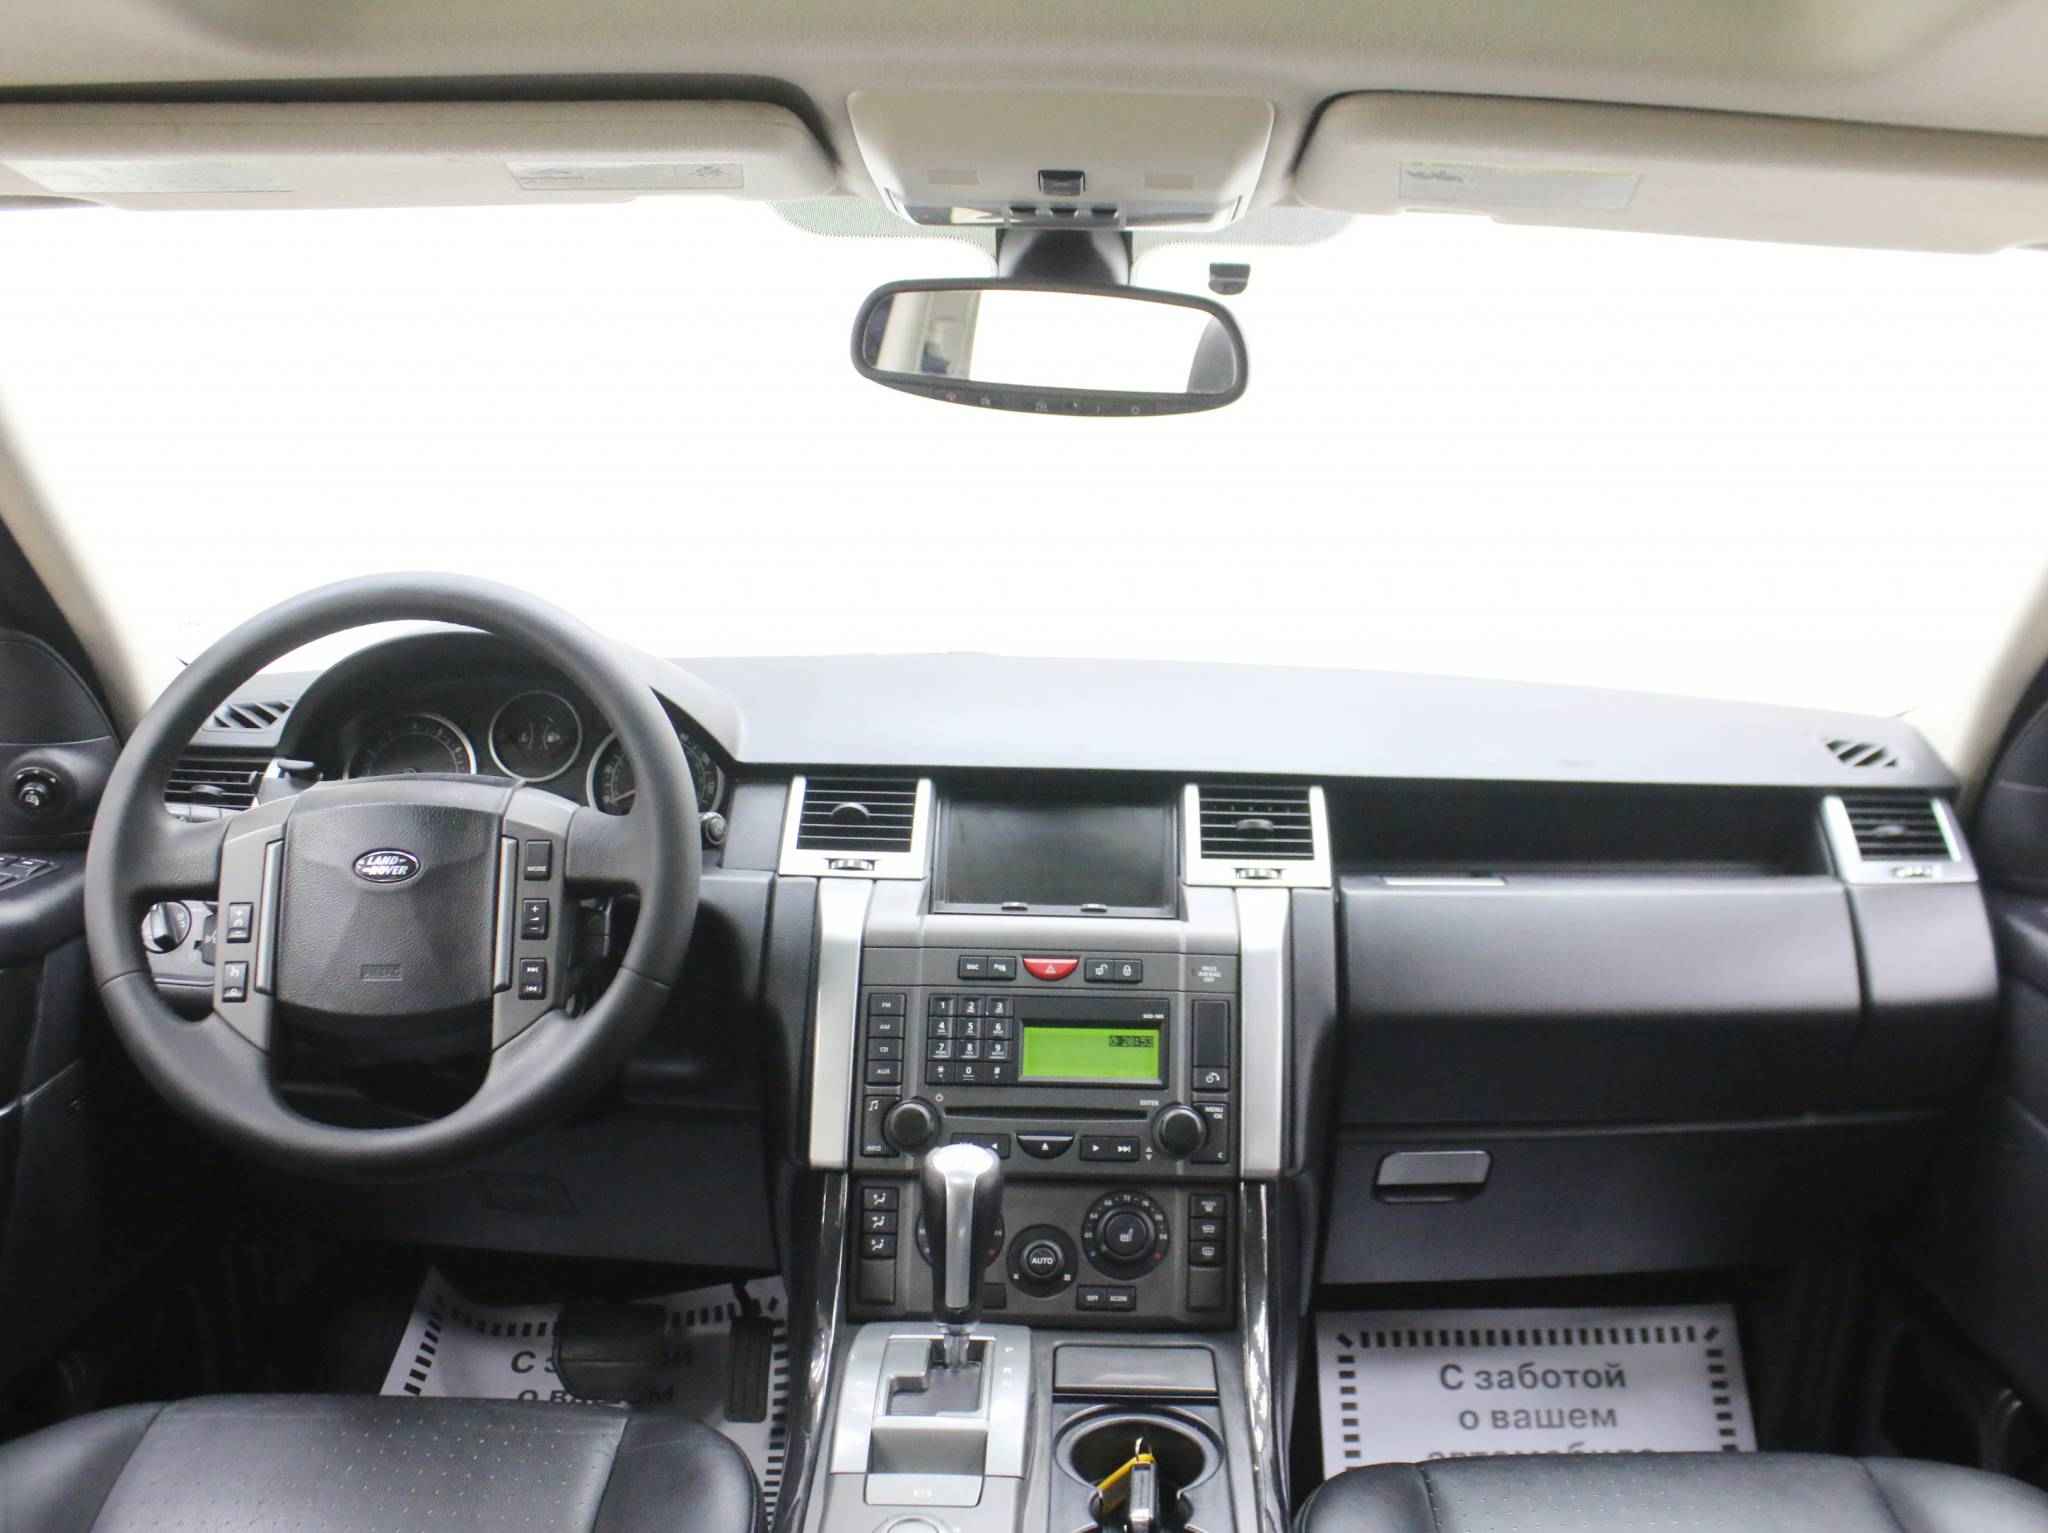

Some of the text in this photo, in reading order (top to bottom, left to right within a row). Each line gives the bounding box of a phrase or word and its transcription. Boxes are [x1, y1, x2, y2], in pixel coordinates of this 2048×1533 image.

[366, 855, 399, 866] LAND
[367, 865, 409, 876] ROVER
[1031, 1257, 1055, 1265] AUTO
[1439, 1361, 1627, 1391] С заботой
[1458, 1406, 1619, 1431] о вашем
